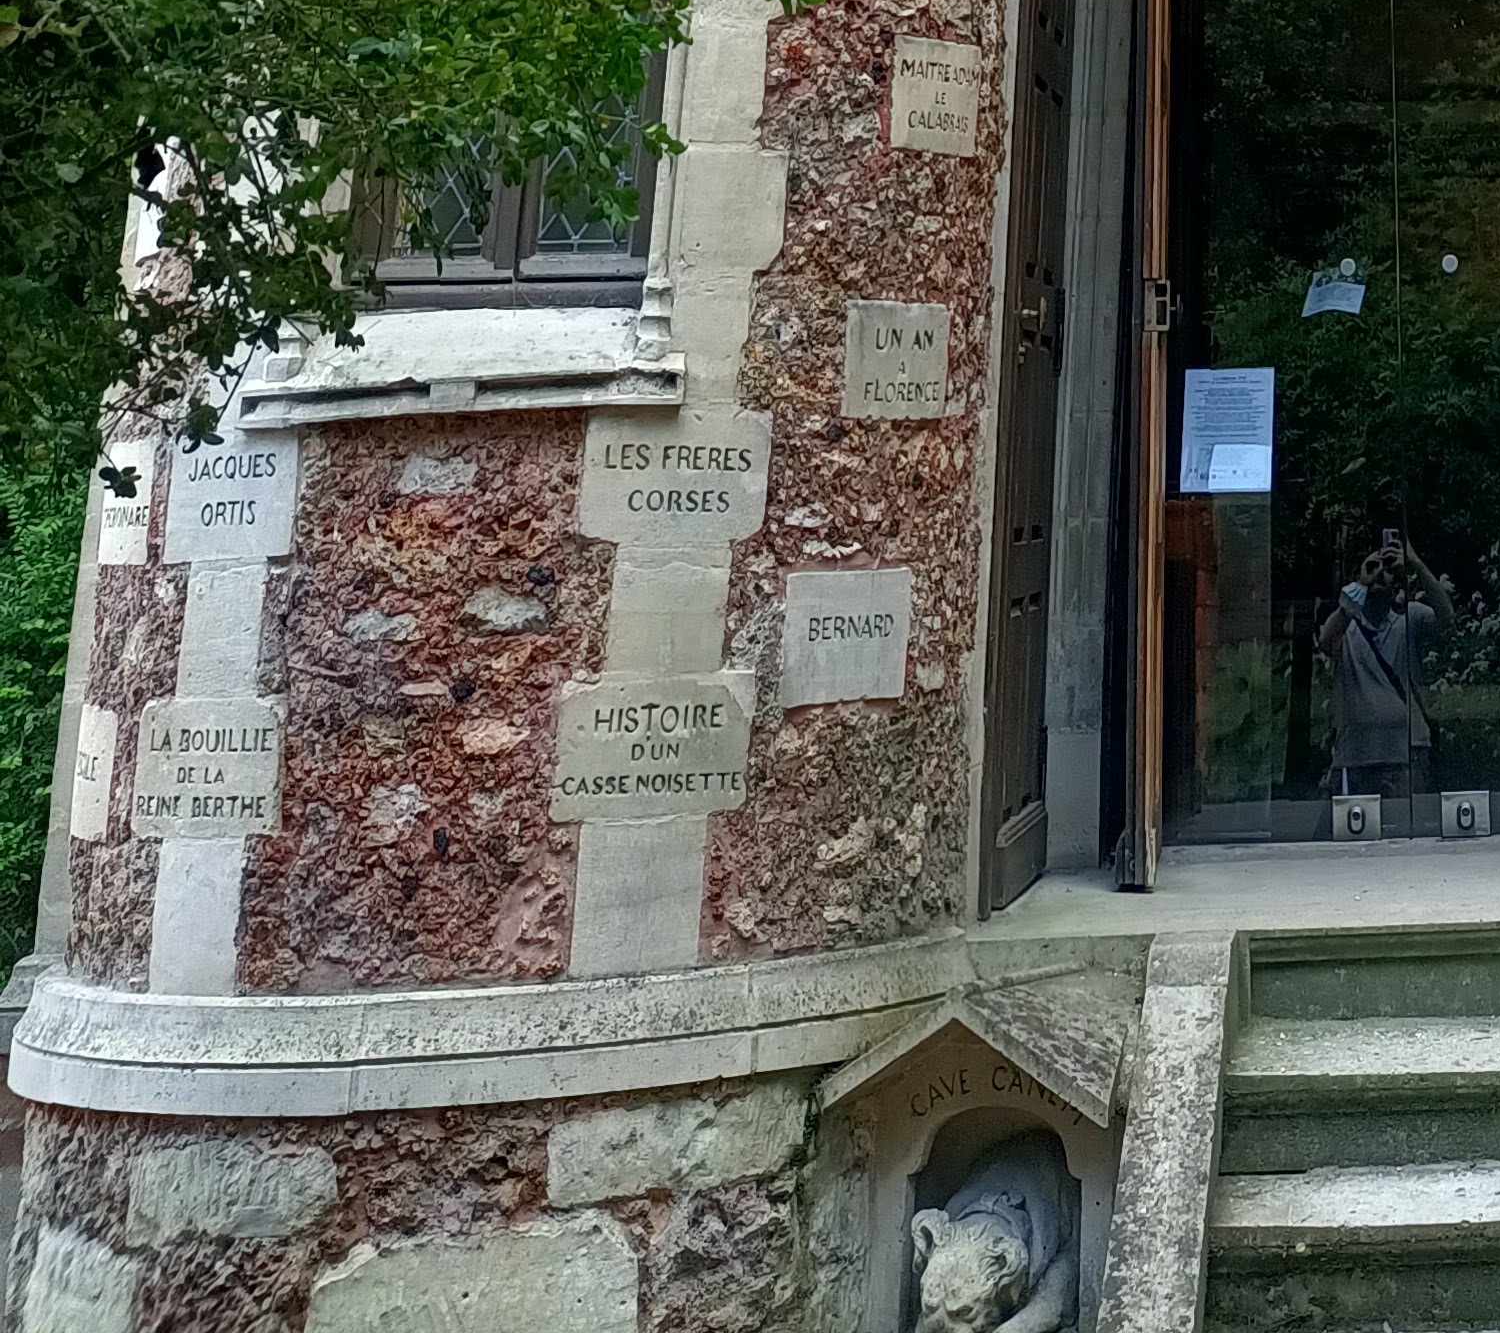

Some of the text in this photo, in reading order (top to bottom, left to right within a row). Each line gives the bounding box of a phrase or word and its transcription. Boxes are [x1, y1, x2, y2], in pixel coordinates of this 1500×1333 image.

[900, 58, 952, 83] MAITRE
[934, 91, 947, 105] LE
[907, 109, 969, 134] CALABRAIS
[875, 327, 934, 351] UN AN
[863, 378, 940, 403] FLORENCE
[188, 452, 277, 483] JACQUES
[604, 443, 753, 473] LES FRERES
[200, 499, 257, 527] ORTIS
[627, 489, 730, 514] CORSES
[808, 613, 895, 642] BERNARD
[594, 701, 725, 734] HISTOIRE
[150, 727, 274, 753] LA BOUILLIE
[630, 735, 680, 761] D'UN
[176, 766, 225, 784] DE LA
[135, 794, 267, 819] REINE BERTHE
[910, 1068, 971, 1117] CAVE
